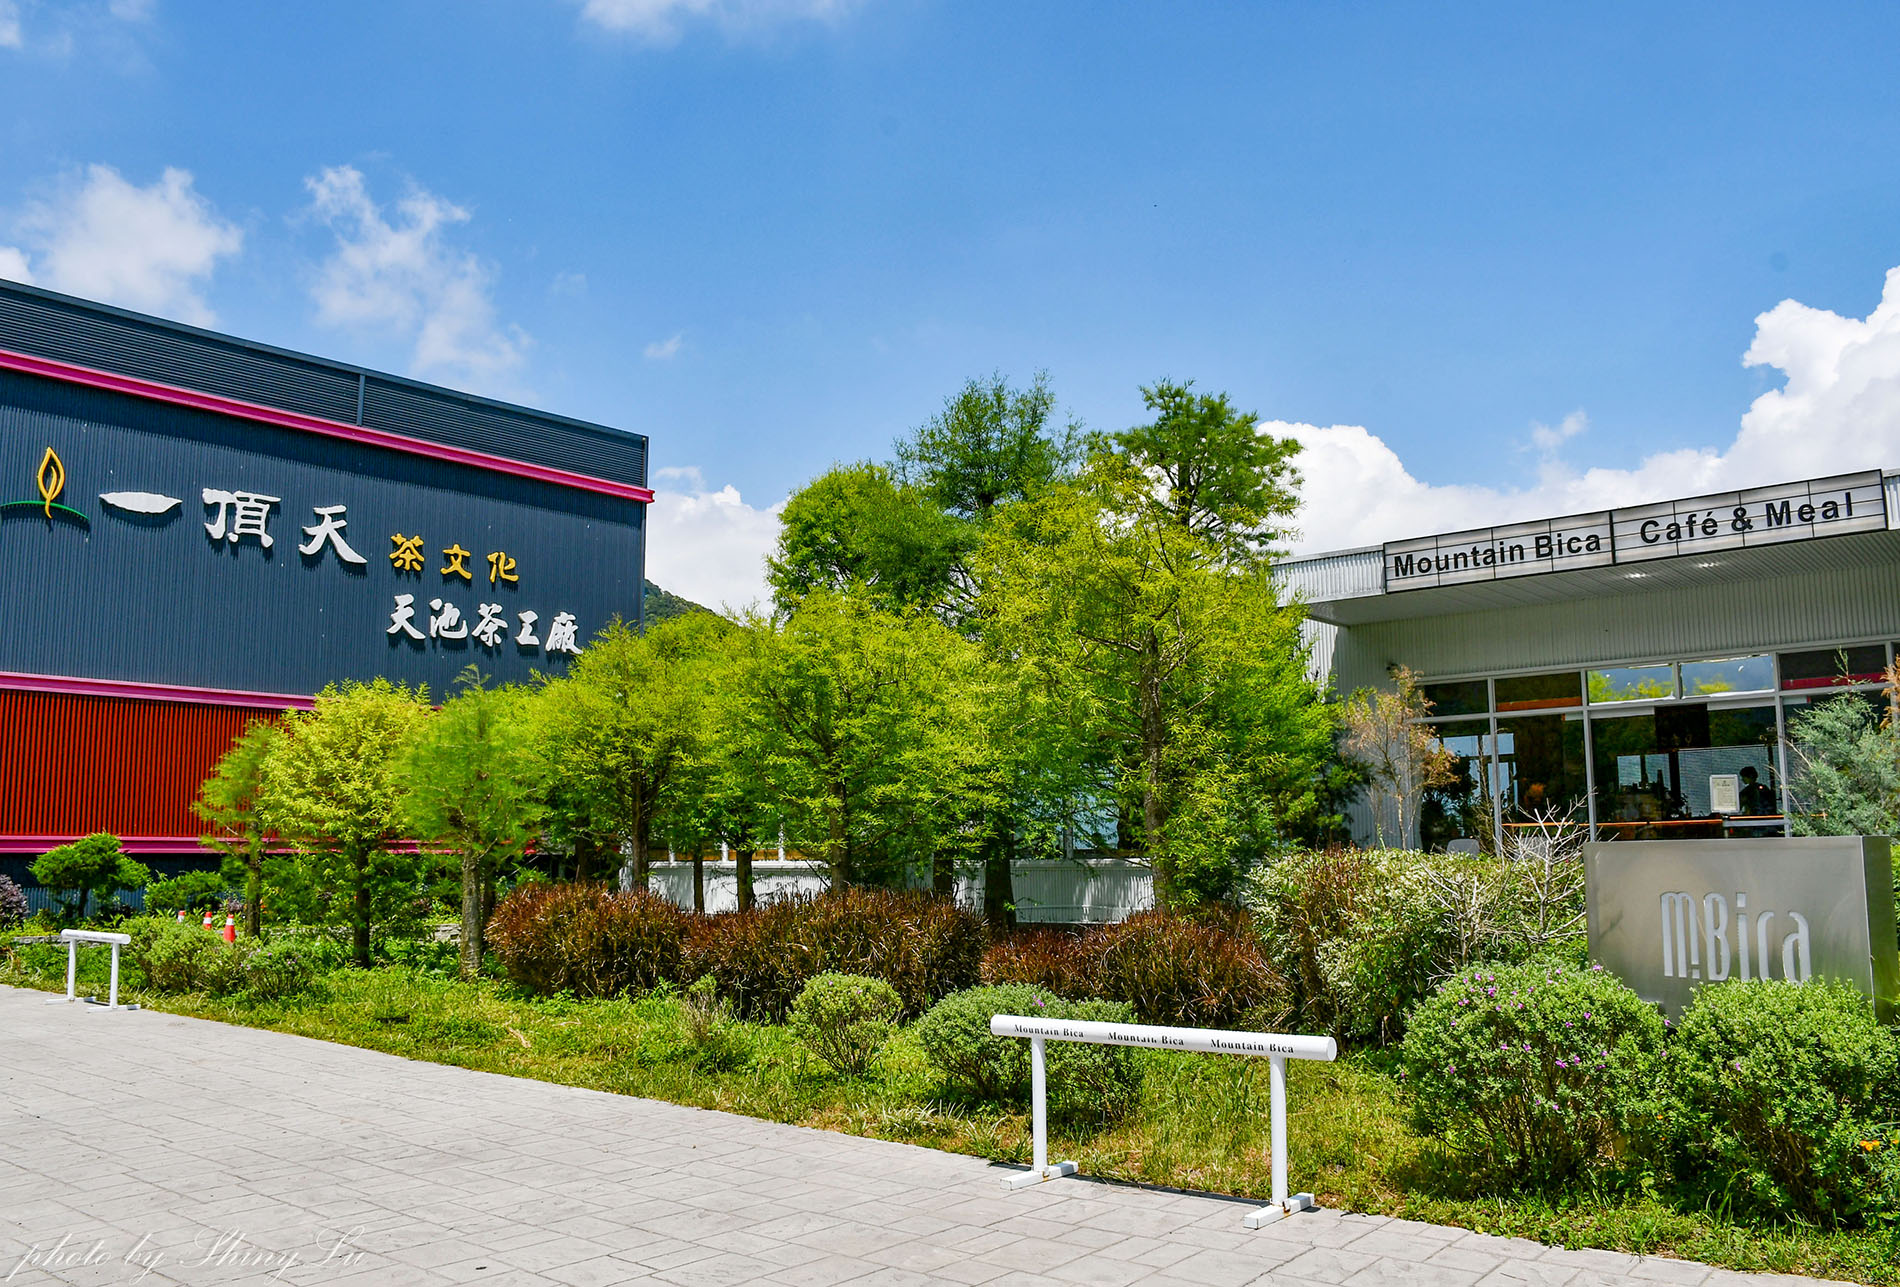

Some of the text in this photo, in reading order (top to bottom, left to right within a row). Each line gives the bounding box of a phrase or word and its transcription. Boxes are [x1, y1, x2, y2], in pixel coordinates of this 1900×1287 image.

[99, 487, 368, 564] 一頂天
[1640, 491, 1853, 544] Café & Meal
[389, 533, 520, 583] 茶文化
[1394, 532, 1601, 577] Mountain Bica
[386, 593, 584, 655] 天池茶工廠
[1014, 1024, 1084, 1038] Mountain Bica
[1161, 1035, 1185, 1046] Bica
[1210, 1038, 1294, 1054] Mountain Bica
